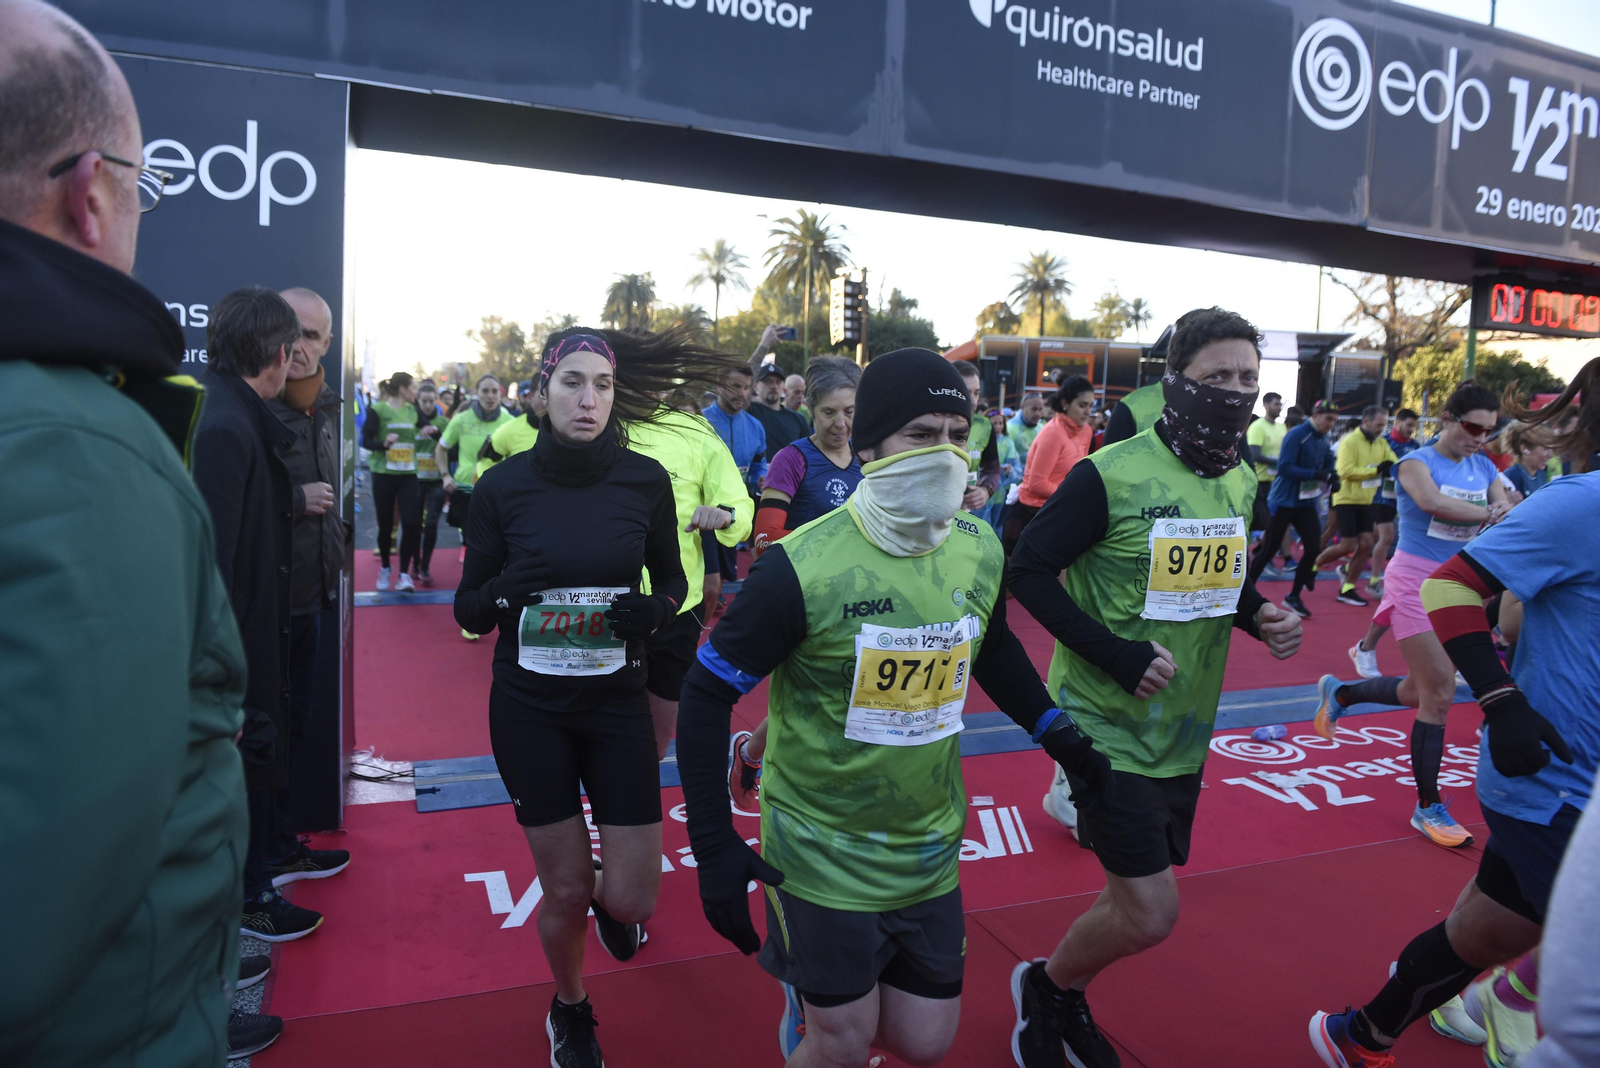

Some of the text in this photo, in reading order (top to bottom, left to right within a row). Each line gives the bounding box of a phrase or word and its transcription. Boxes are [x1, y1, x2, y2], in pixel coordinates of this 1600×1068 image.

[707, 0, 812, 30] Motor
[1005, 4, 1204, 71] quirónsalud
[1037, 58, 1201, 110] Healthcare Partner
[1379, 46, 1491, 150] edp
[143, 119, 317, 227] edp
[1475, 185, 1600, 234] 29 enero 202
[1141, 505, 1182, 519] HOKA
[954, 517, 979, 535] 2023
[1179, 524, 1199, 536] edp
[1168, 545, 1228, 575] 9718
[548, 592, 567, 602] edp
[843, 597, 896, 619] HOKA
[539, 611, 605, 637] 7018
[894, 634, 918, 649] edp
[572, 650, 590, 660] edp
[873, 700, 903, 709] Manuel
